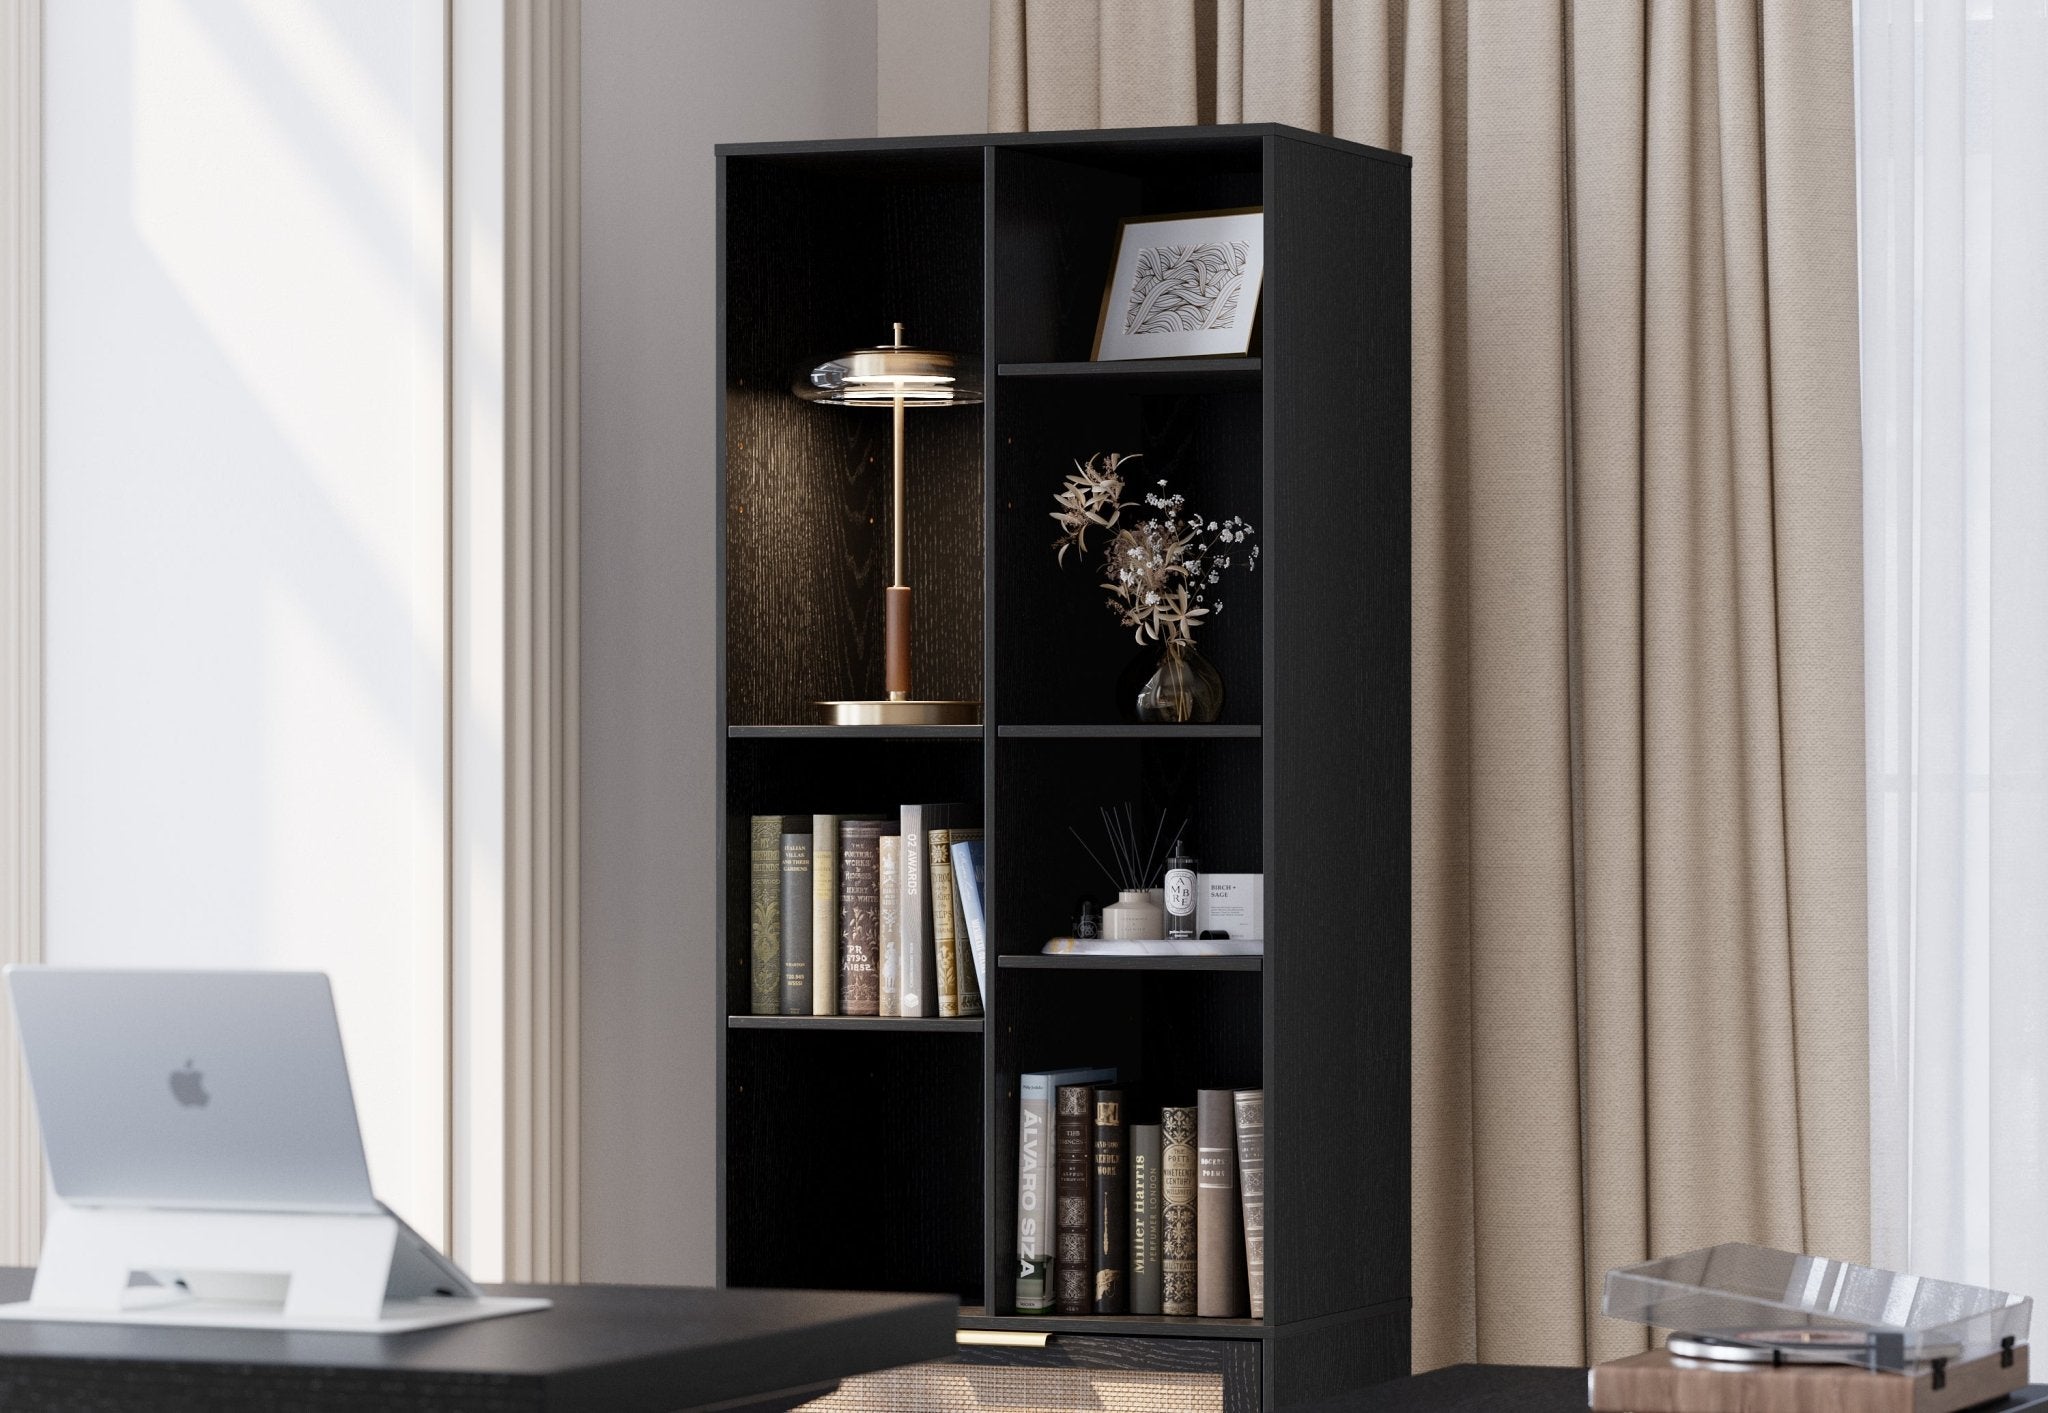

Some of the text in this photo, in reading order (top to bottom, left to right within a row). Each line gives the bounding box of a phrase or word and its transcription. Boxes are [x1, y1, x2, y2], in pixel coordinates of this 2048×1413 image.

[908, 849, 917, 896] AWARDS
[847, 945, 862, 954] PR
[1021, 1109, 1042, 1212] ÁLVARO
[1097, 1166, 1117, 1176] WORK
[1202, 1169, 1226, 1177] POEMS
[1165, 1178, 1192, 1186] CENTURY
[1134, 1154, 1145, 1275] Miller Harris
[1020, 1217, 1036, 1279] SIZA
